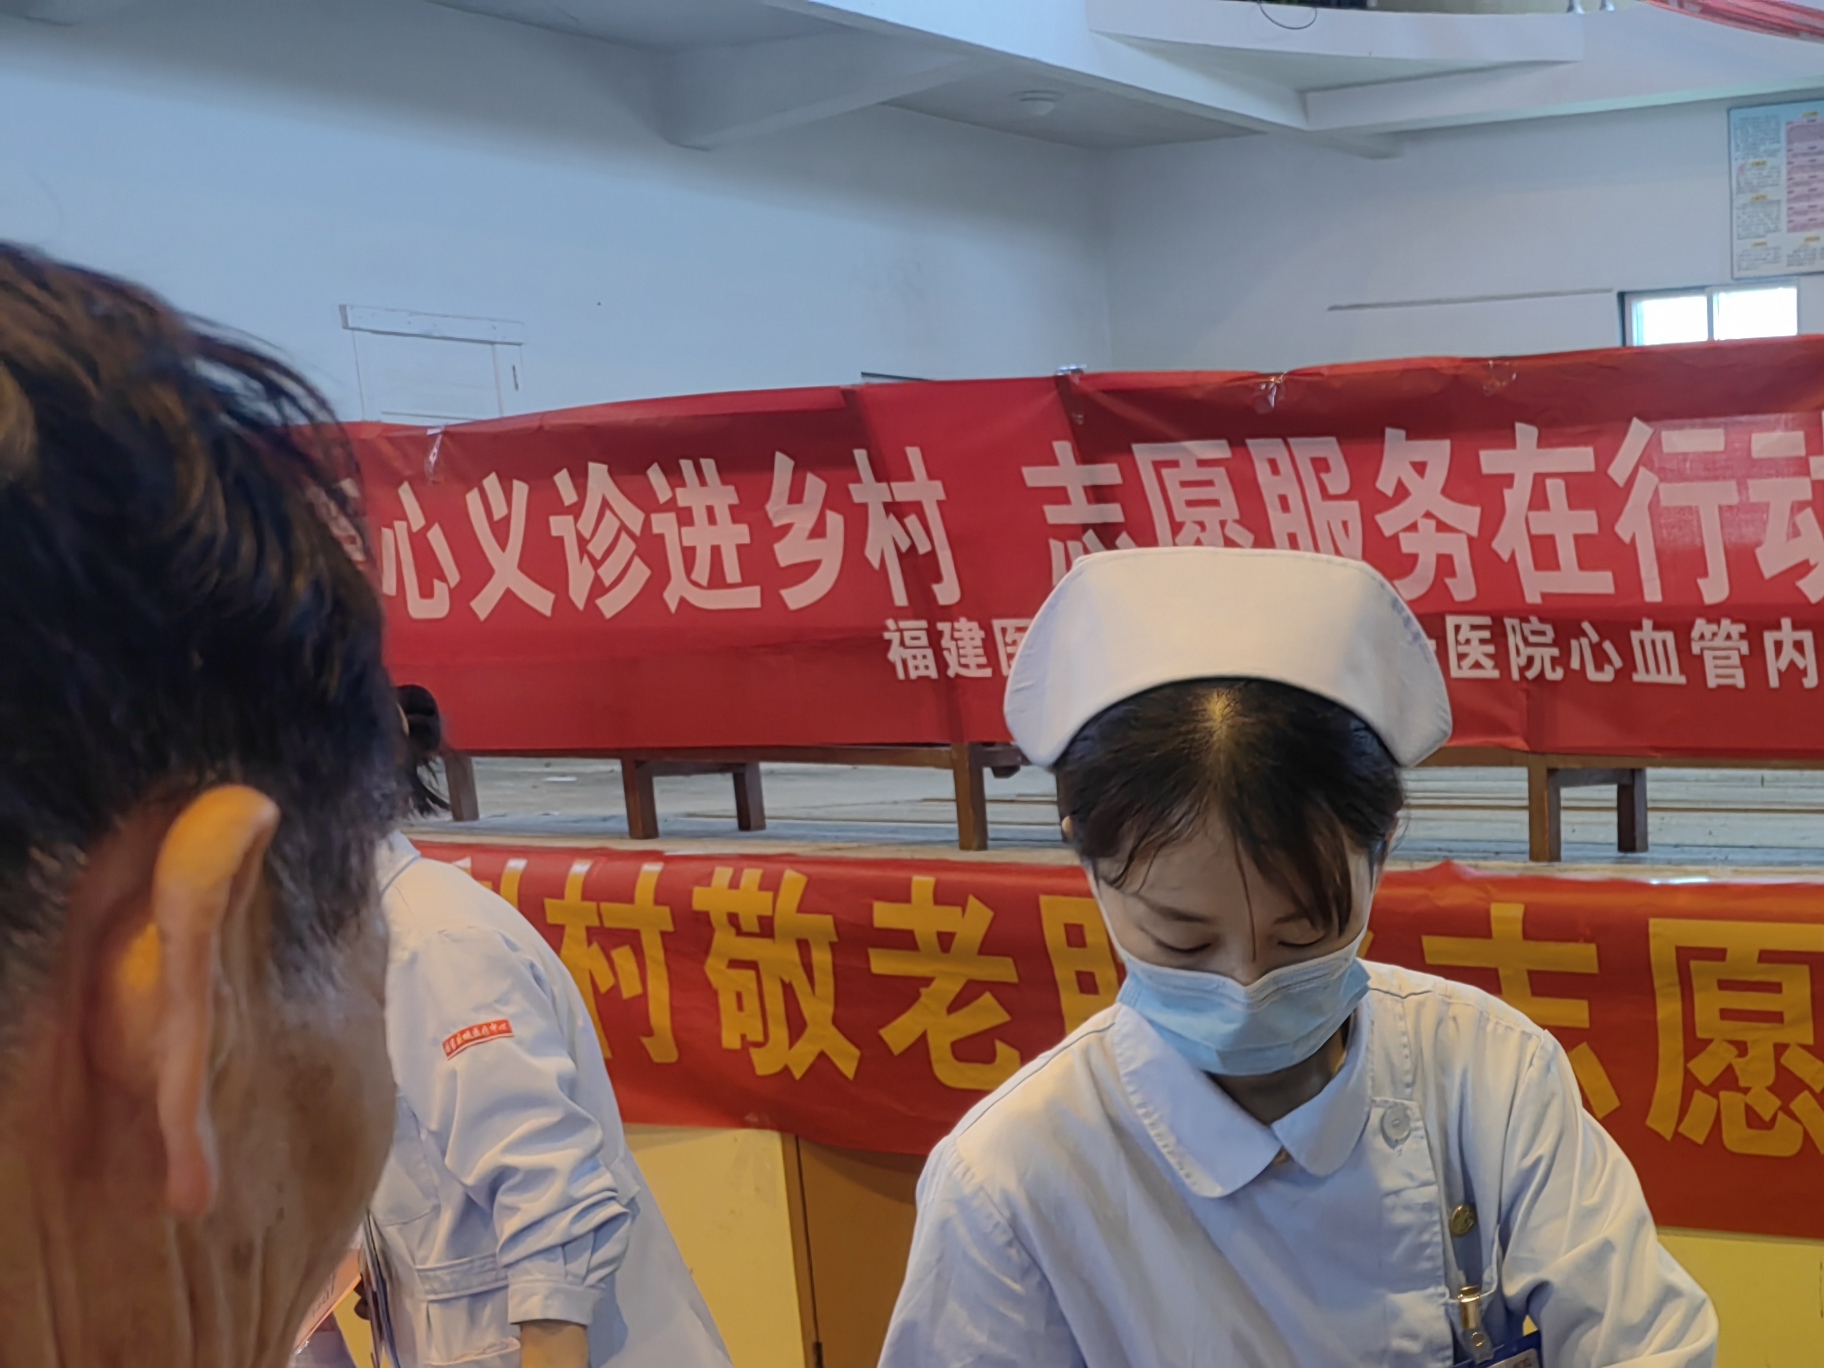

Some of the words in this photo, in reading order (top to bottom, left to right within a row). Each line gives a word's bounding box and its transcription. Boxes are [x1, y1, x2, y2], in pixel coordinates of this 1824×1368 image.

[320, 447, 962, 622] 心义诊进乡村
[453, 857, 1120, 1091] 村敬老
